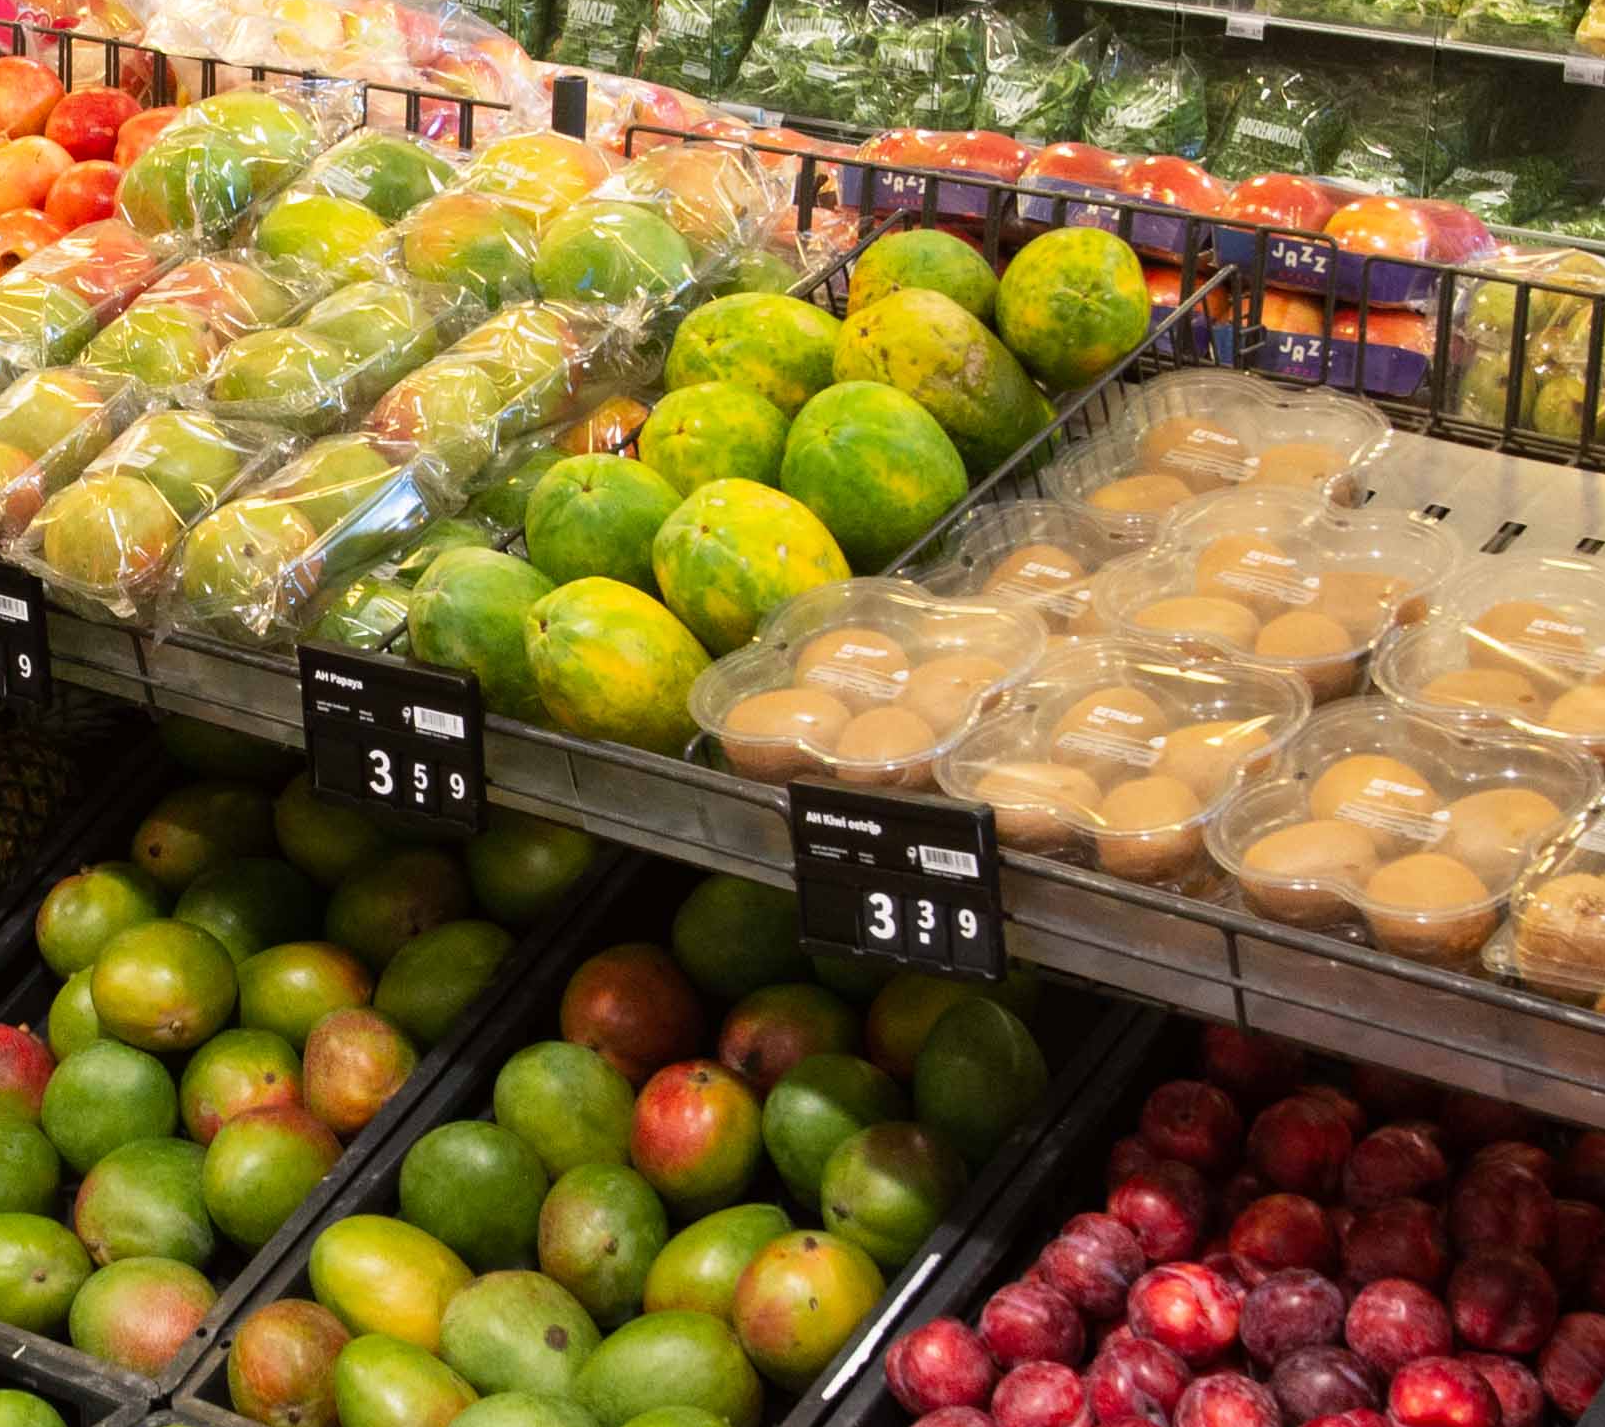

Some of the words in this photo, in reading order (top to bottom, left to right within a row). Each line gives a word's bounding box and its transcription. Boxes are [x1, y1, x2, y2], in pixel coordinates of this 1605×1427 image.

[1272, 240, 1328, 274] JAZZ
[315, 669, 328, 682] AH
[330, 672, 363, 690] Papaya
[369, 749, 466, 803] 3.59
[806, 811, 822, 824] AH
[823, 813, 846, 829] Kiwi
[868, 892, 978, 945] 3.39
